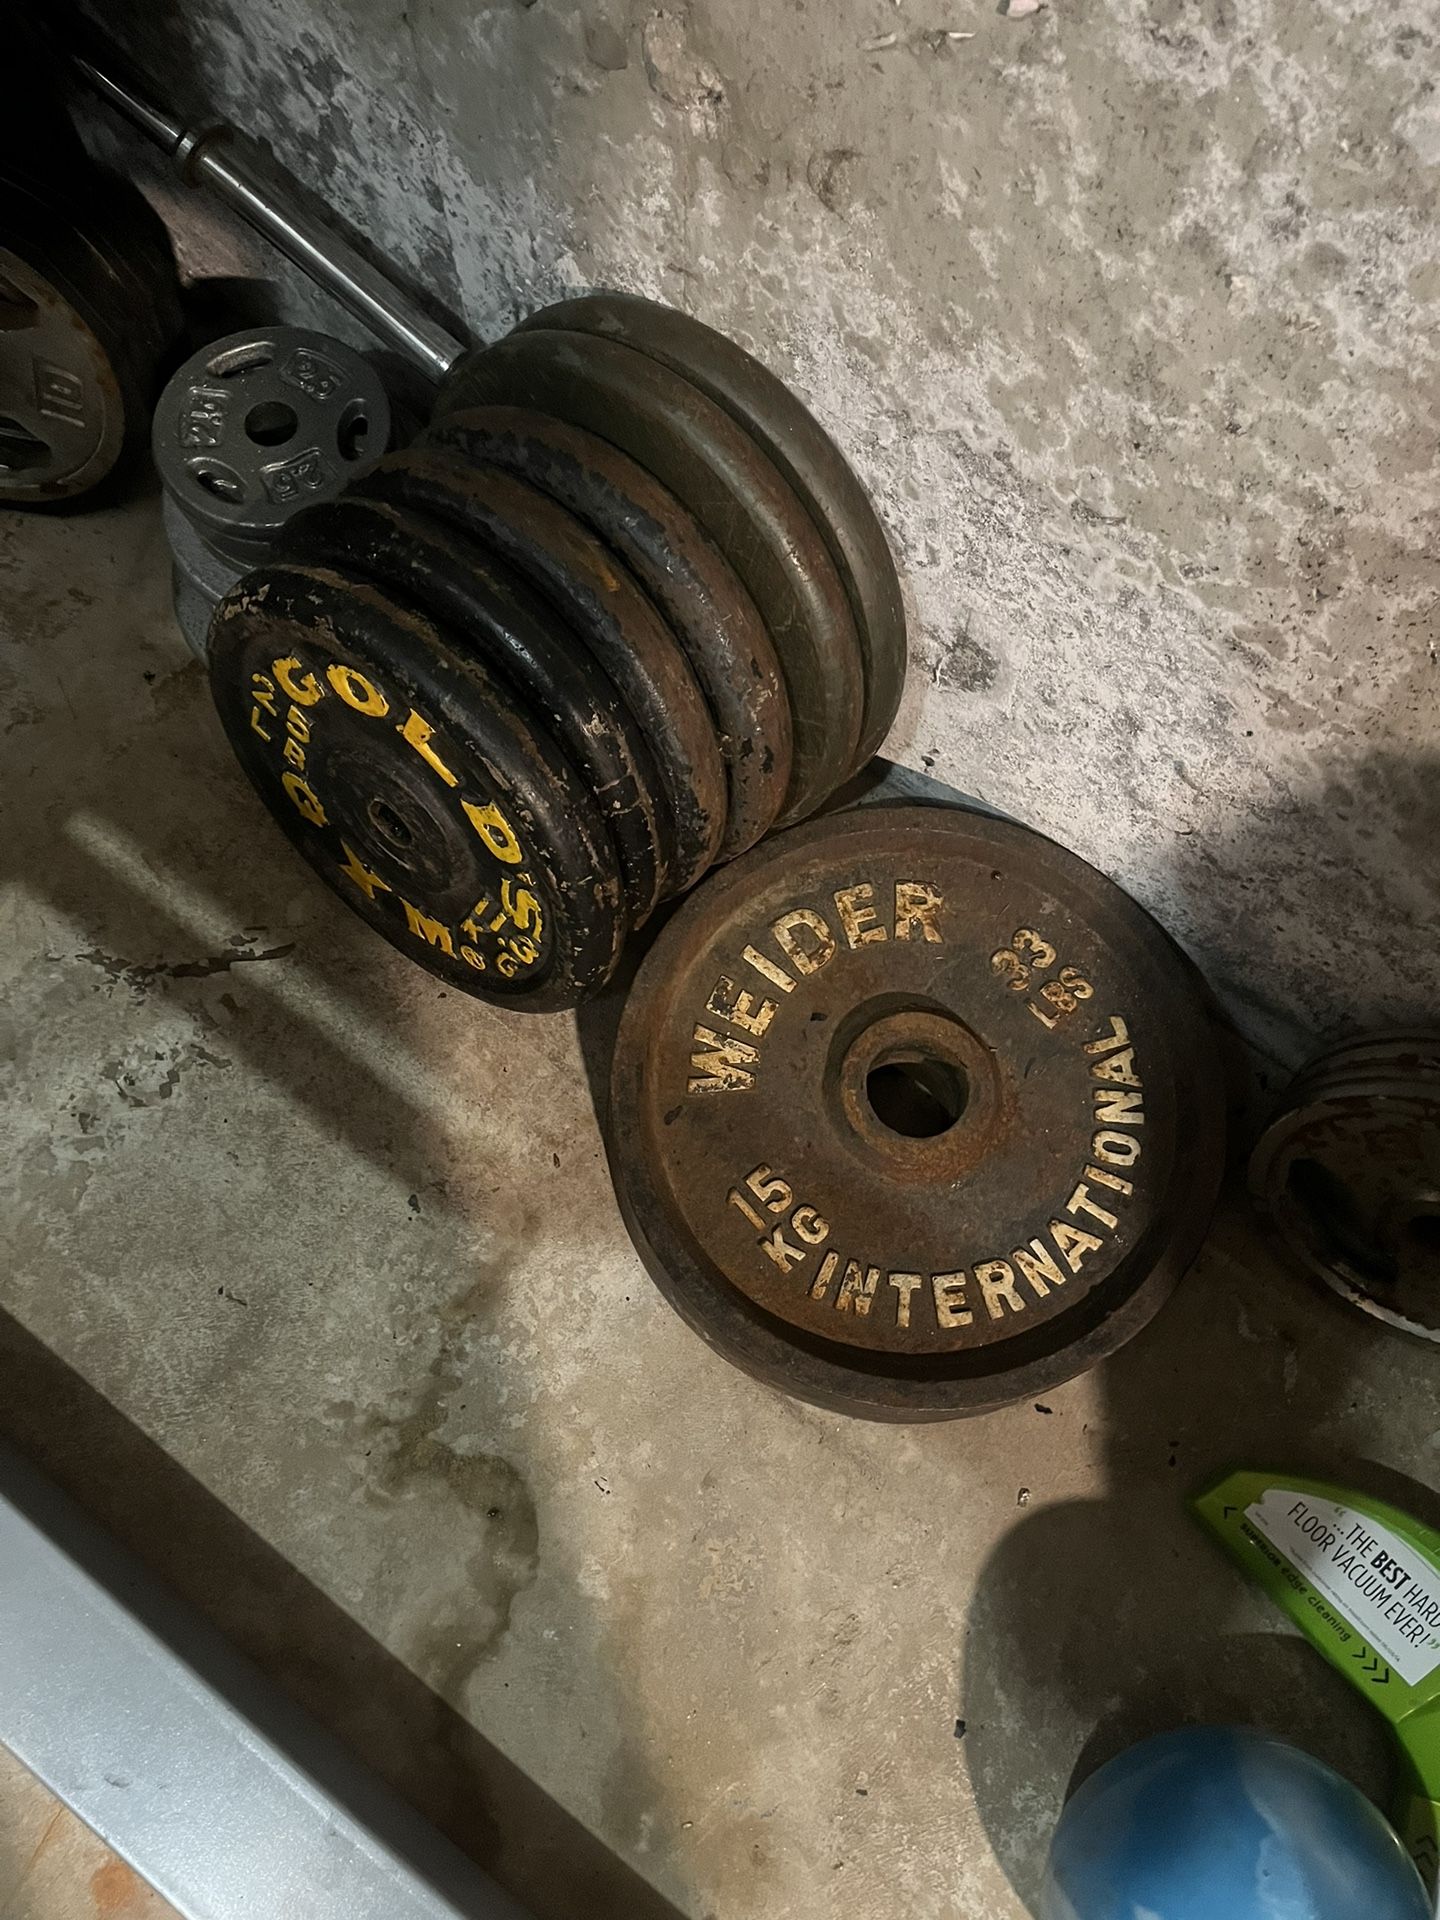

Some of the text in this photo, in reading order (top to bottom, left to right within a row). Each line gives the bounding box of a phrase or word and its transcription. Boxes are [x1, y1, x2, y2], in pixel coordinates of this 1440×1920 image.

[687, 879, 945, 1093] WEIDER
[990, 928, 1058, 990] 33
[1027, 966, 1095, 1030] LBS
[726, 1163, 794, 1231] 15
[808, 1015, 1145, 1329] INTERNATIONAL
[760, 1204, 830, 1274] KG
[1287, 1501, 1336, 1552] FLOOR
[1331, 1543, 1393, 1609] VACUUM
[1370, 1549, 1412, 1590] BEST
[1307, 1596, 1352, 1642] cleaning
